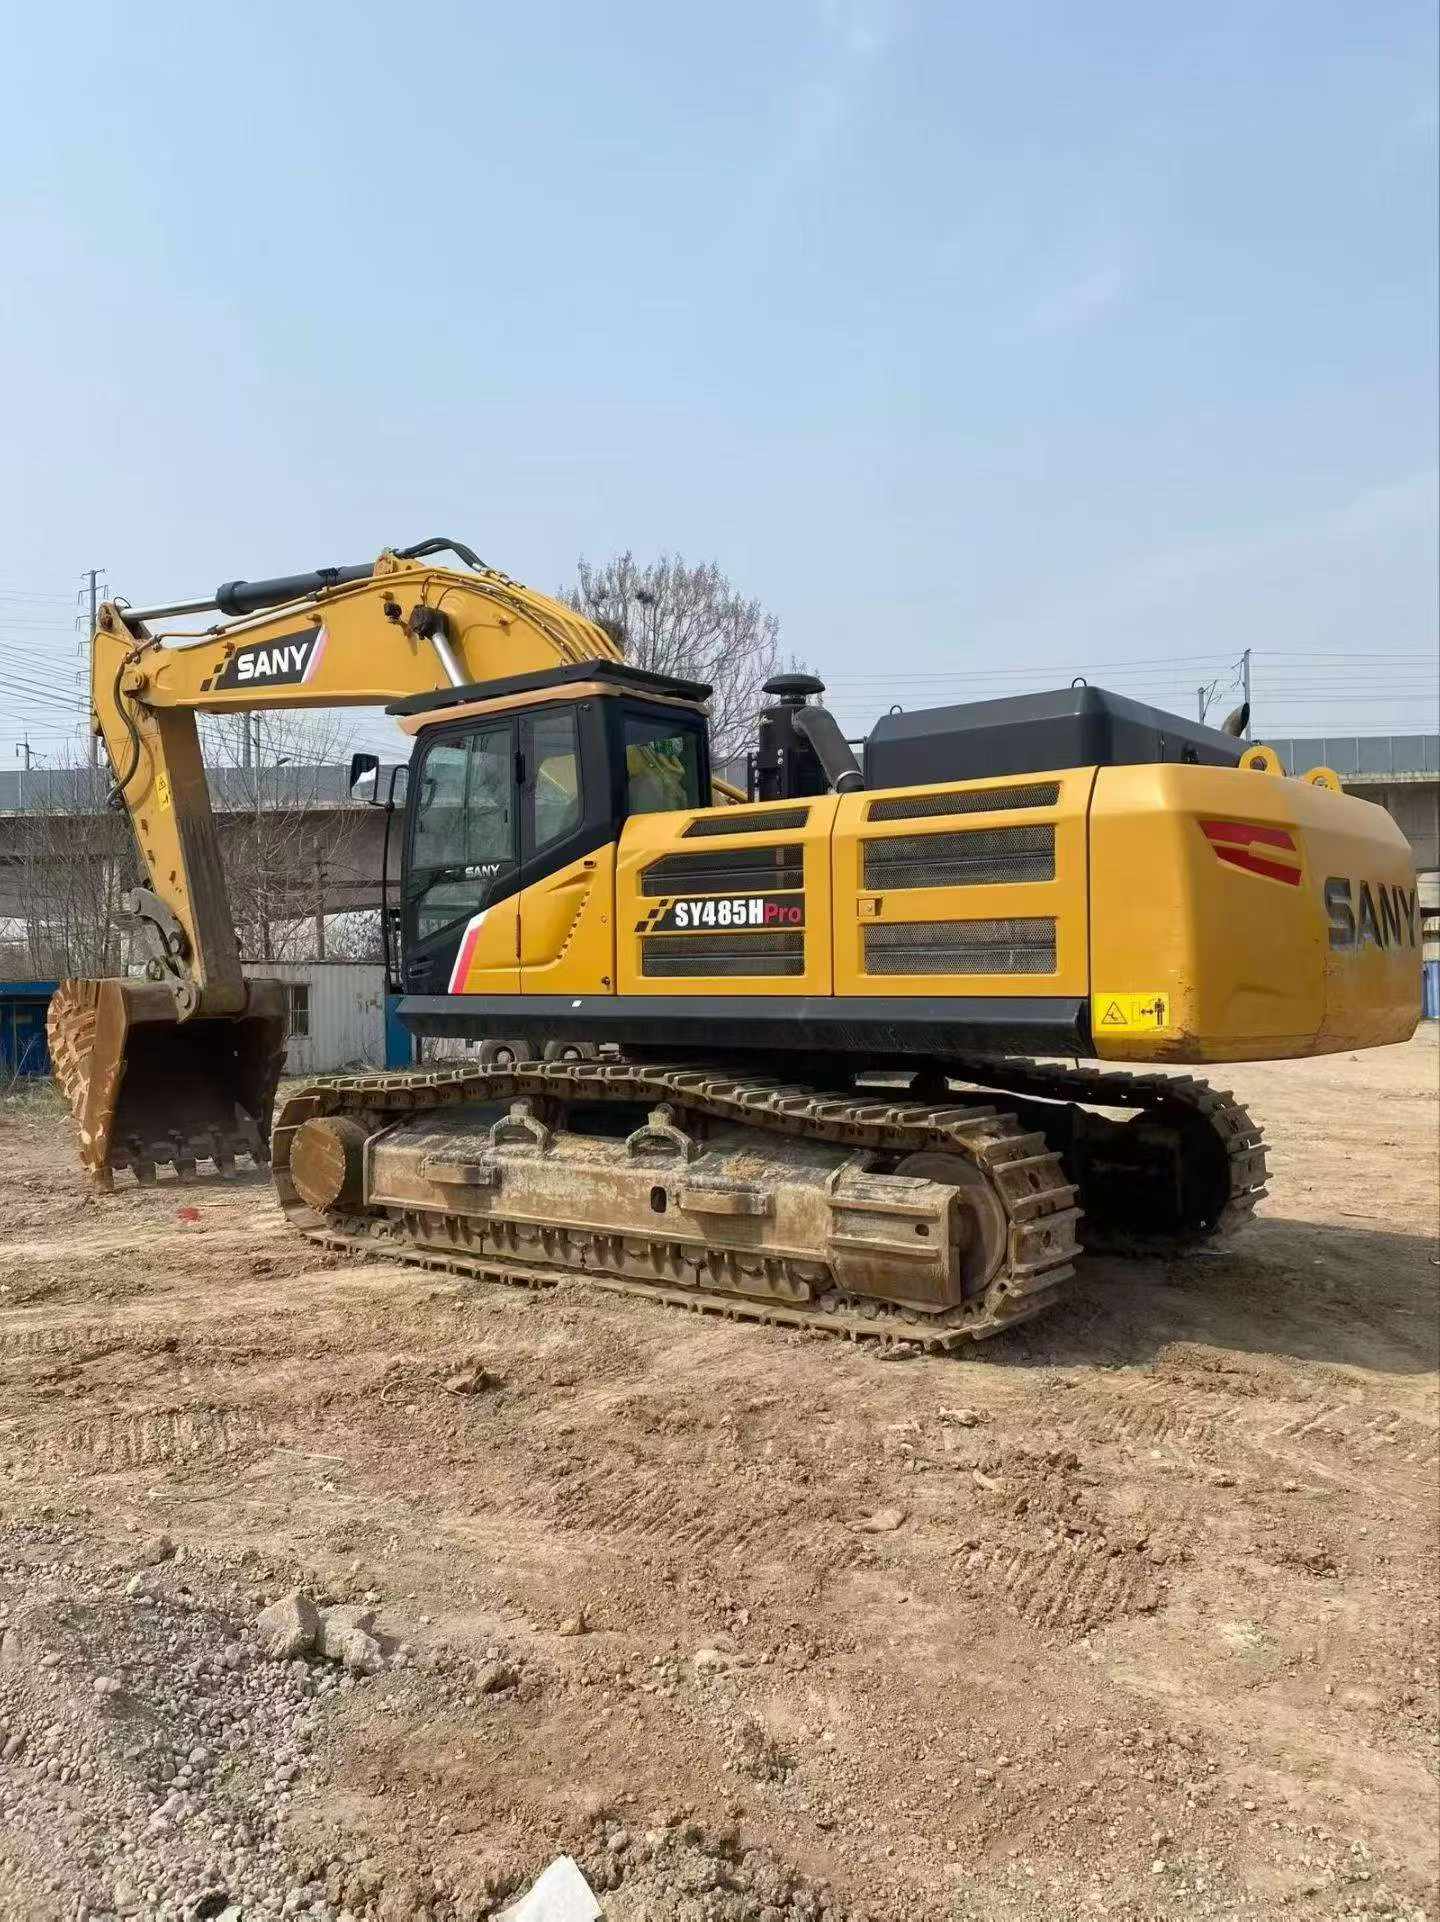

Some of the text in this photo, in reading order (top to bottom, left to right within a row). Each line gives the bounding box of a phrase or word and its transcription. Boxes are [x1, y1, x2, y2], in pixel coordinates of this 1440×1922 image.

[237, 642, 309, 680] SANY
[465, 864, 500, 879] SANY
[1324, 877, 1417, 951] SANY
